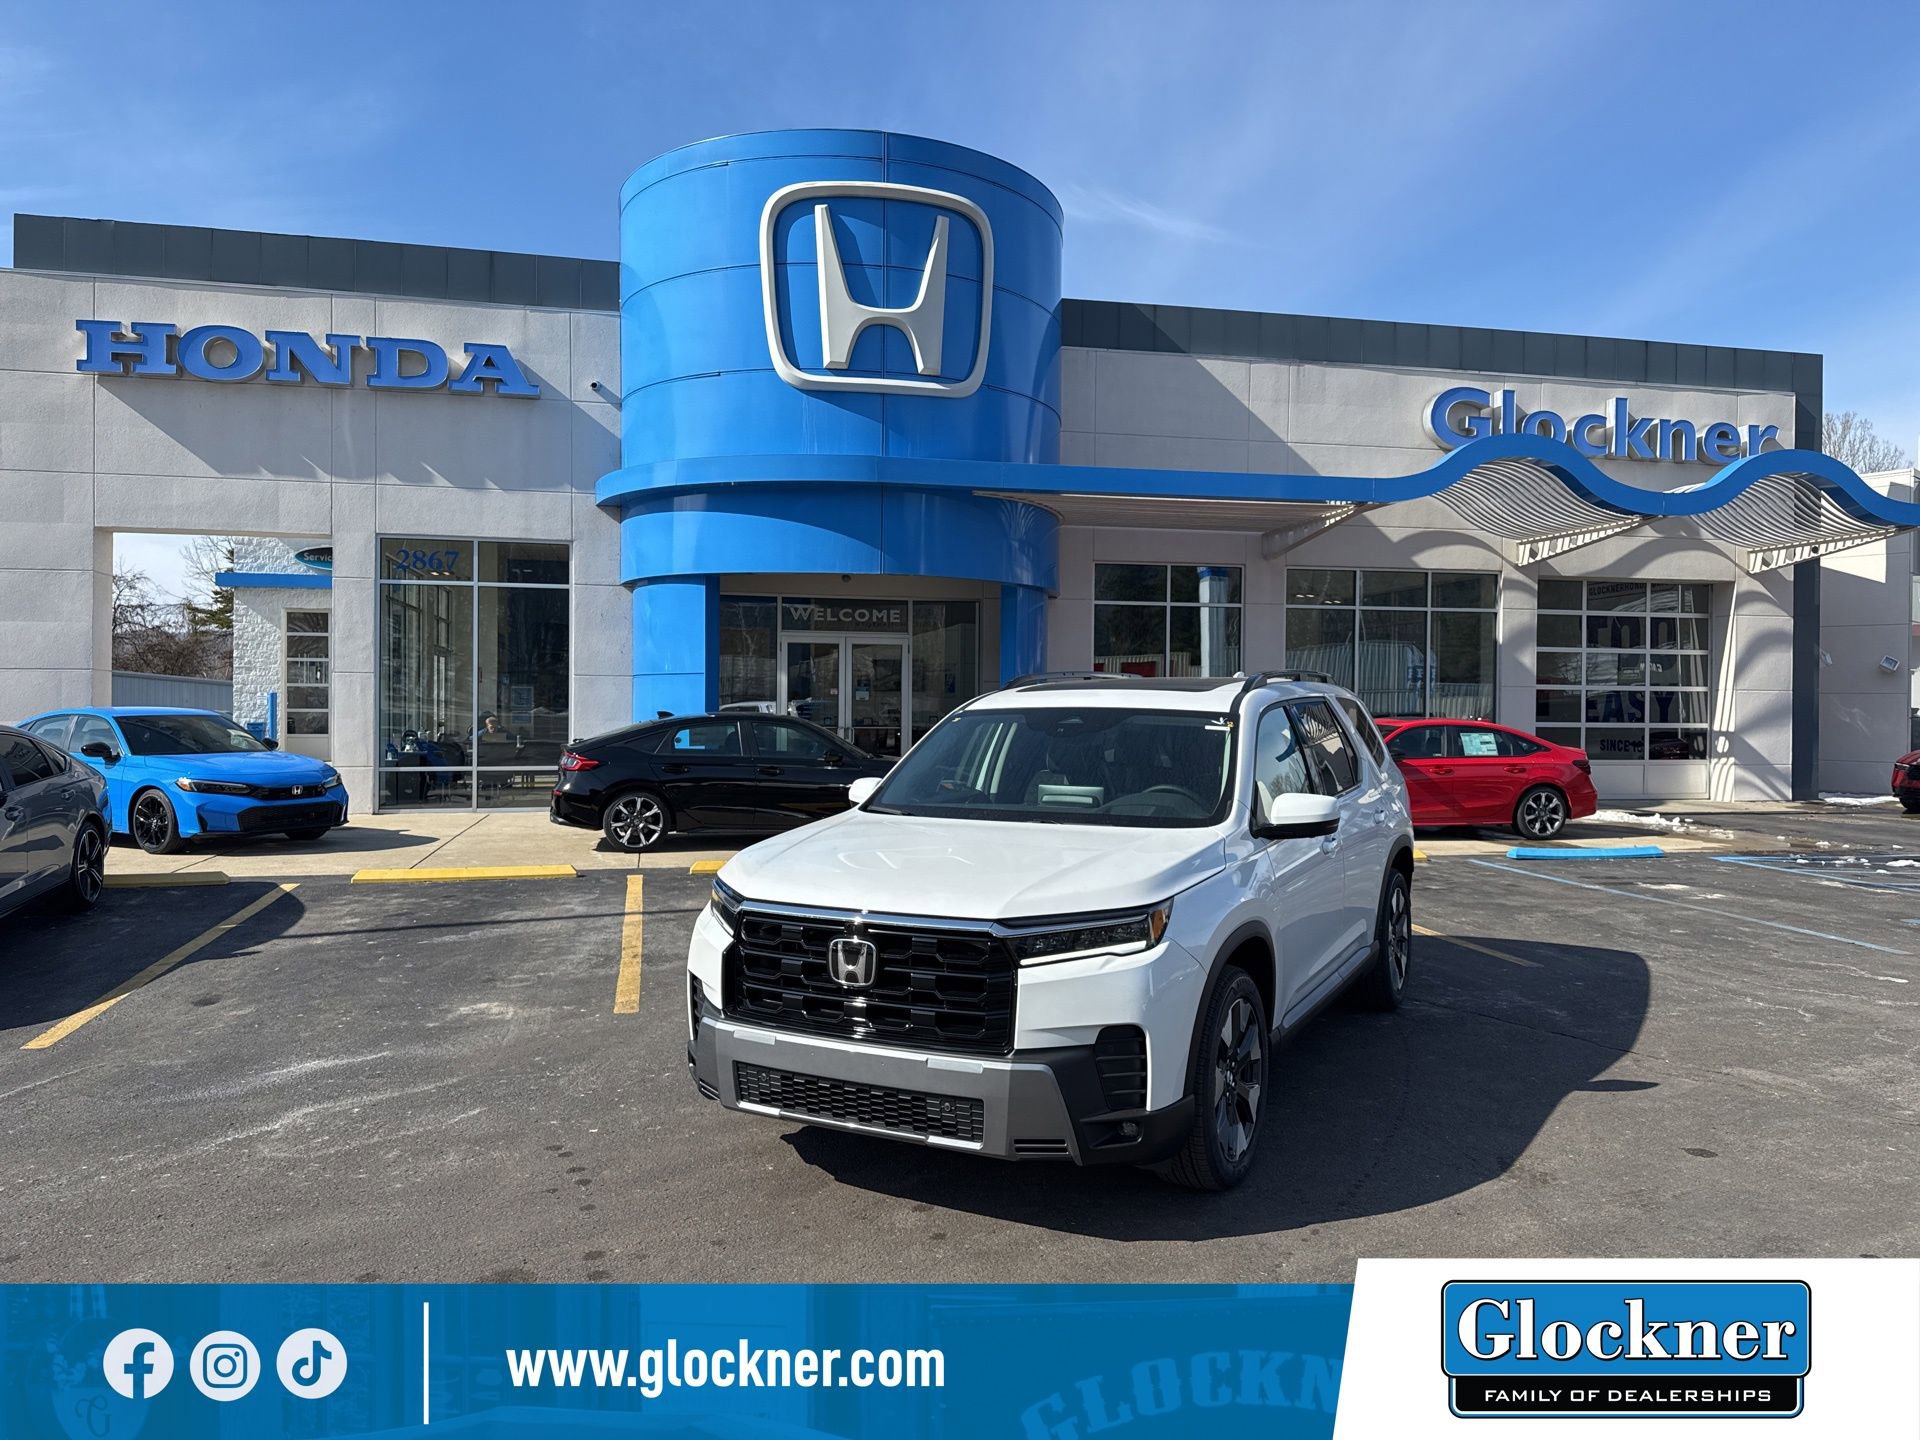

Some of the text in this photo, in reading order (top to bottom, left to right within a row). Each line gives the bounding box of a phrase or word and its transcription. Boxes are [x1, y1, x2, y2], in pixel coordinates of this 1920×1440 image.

[75, 319, 541, 399] HONDA
[1426, 385, 1780, 463] Glockner
[303, 552, 332, 562] Servic
[396, 548, 460, 571] 2867
[789, 607, 901, 623] WELCOME
[1583, 687, 1676, 724] EASY
[1599, 739, 1630, 752] SINCE
